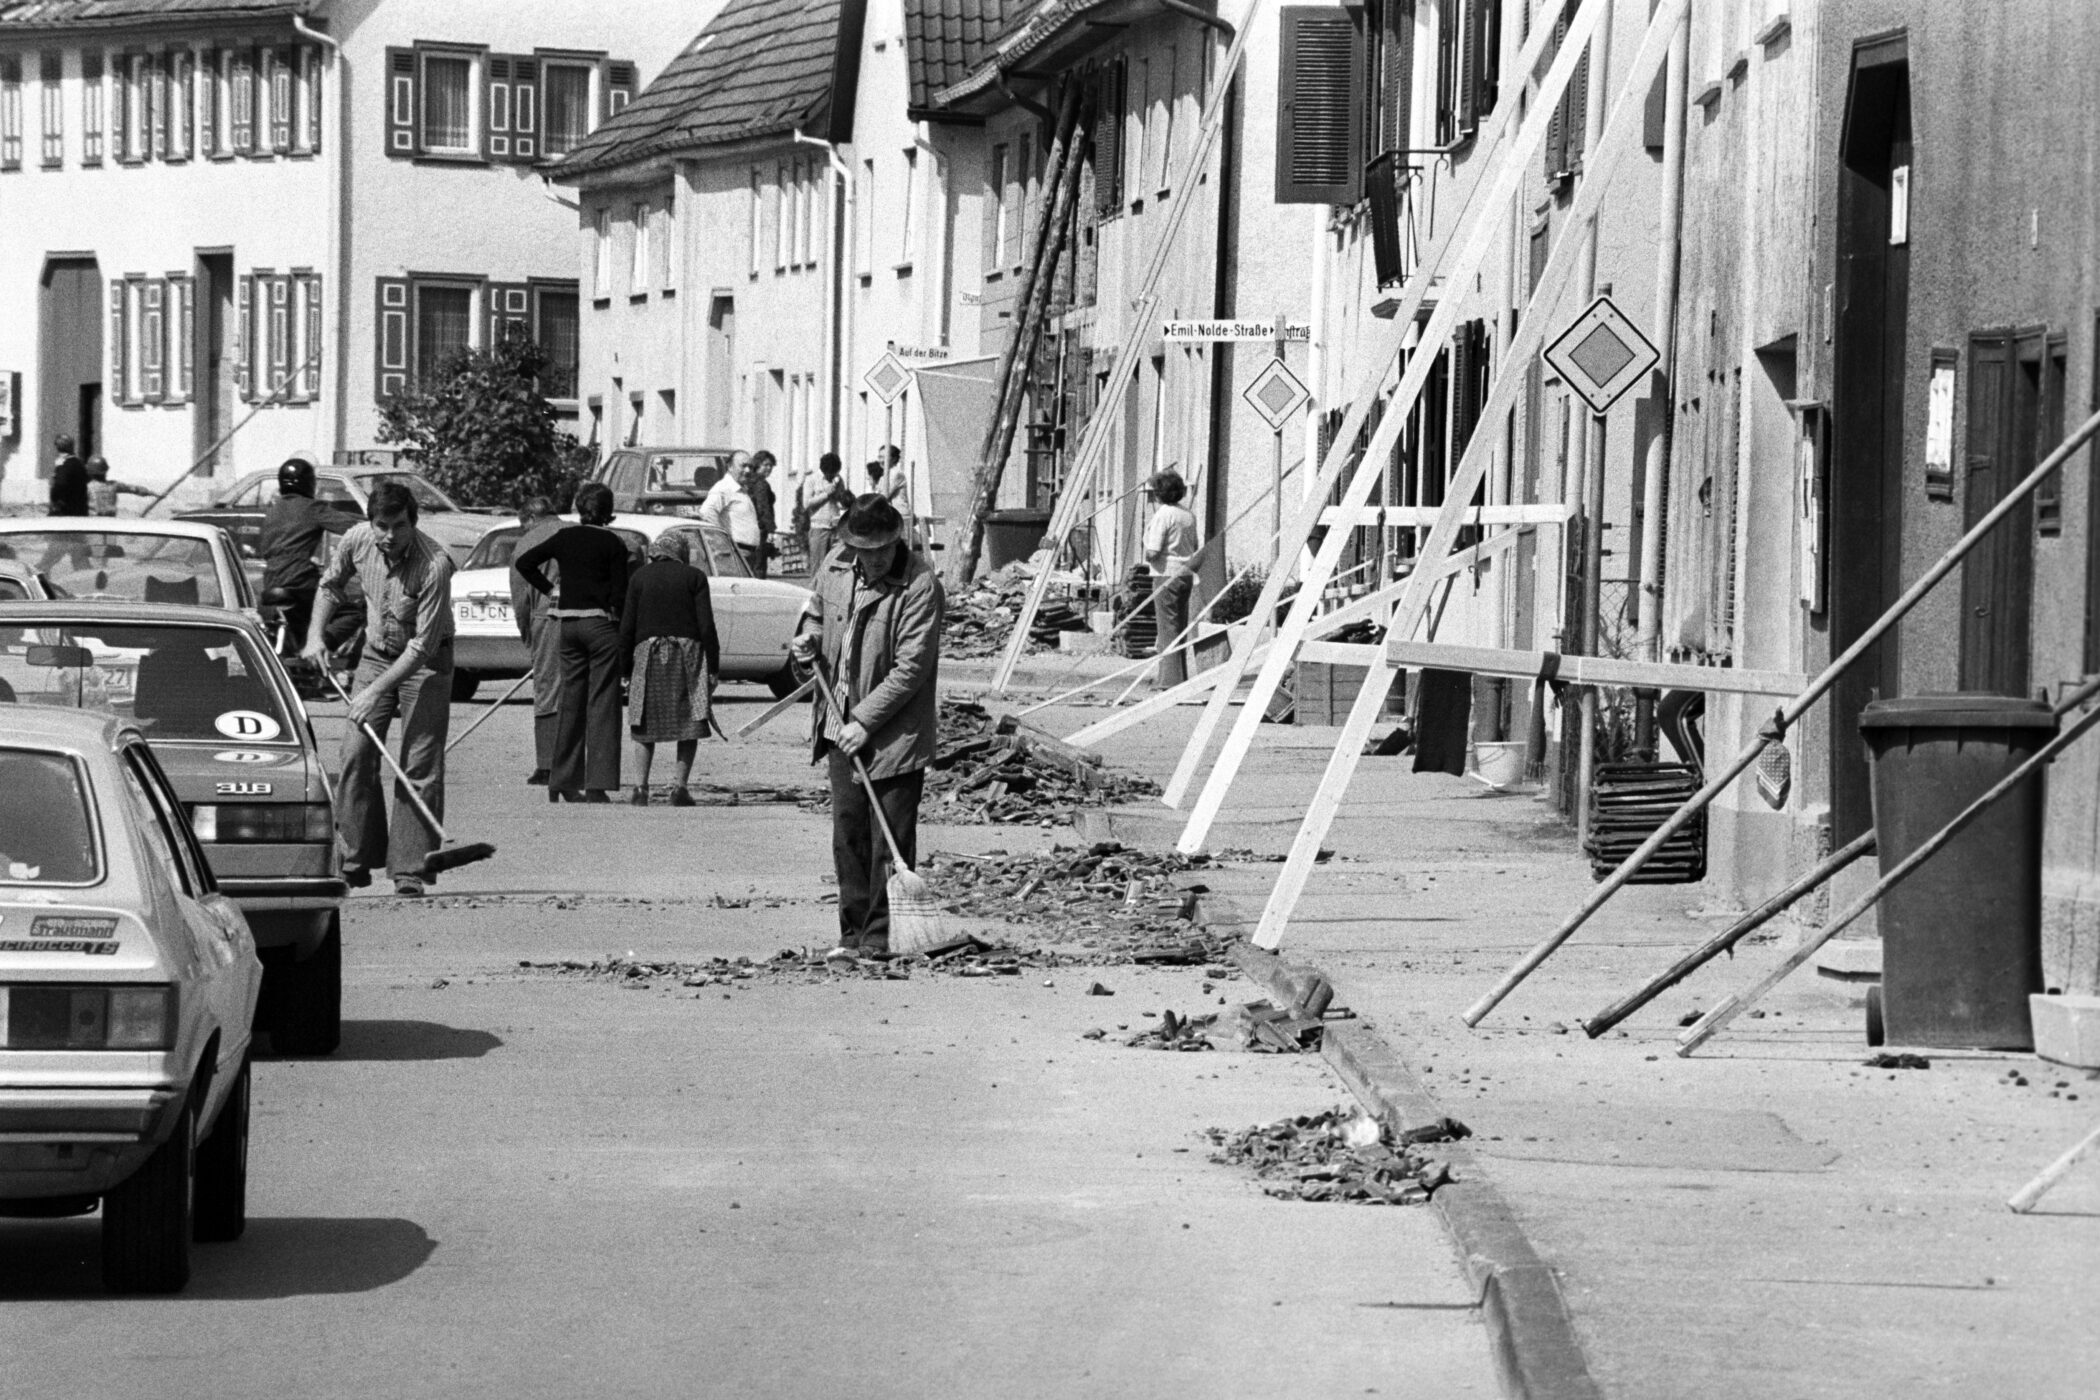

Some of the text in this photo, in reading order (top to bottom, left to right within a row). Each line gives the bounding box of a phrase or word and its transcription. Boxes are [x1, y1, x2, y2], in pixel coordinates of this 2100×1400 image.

[1170, 323, 1268, 337] Emil-Nolde-Straße
[899, 347, 912, 357] Auf
[914, 348, 926, 358] der
[233, 716, 263, 735] D
[216, 782, 272, 795] 318
[0, 940, 85, 952] CIROCCO
